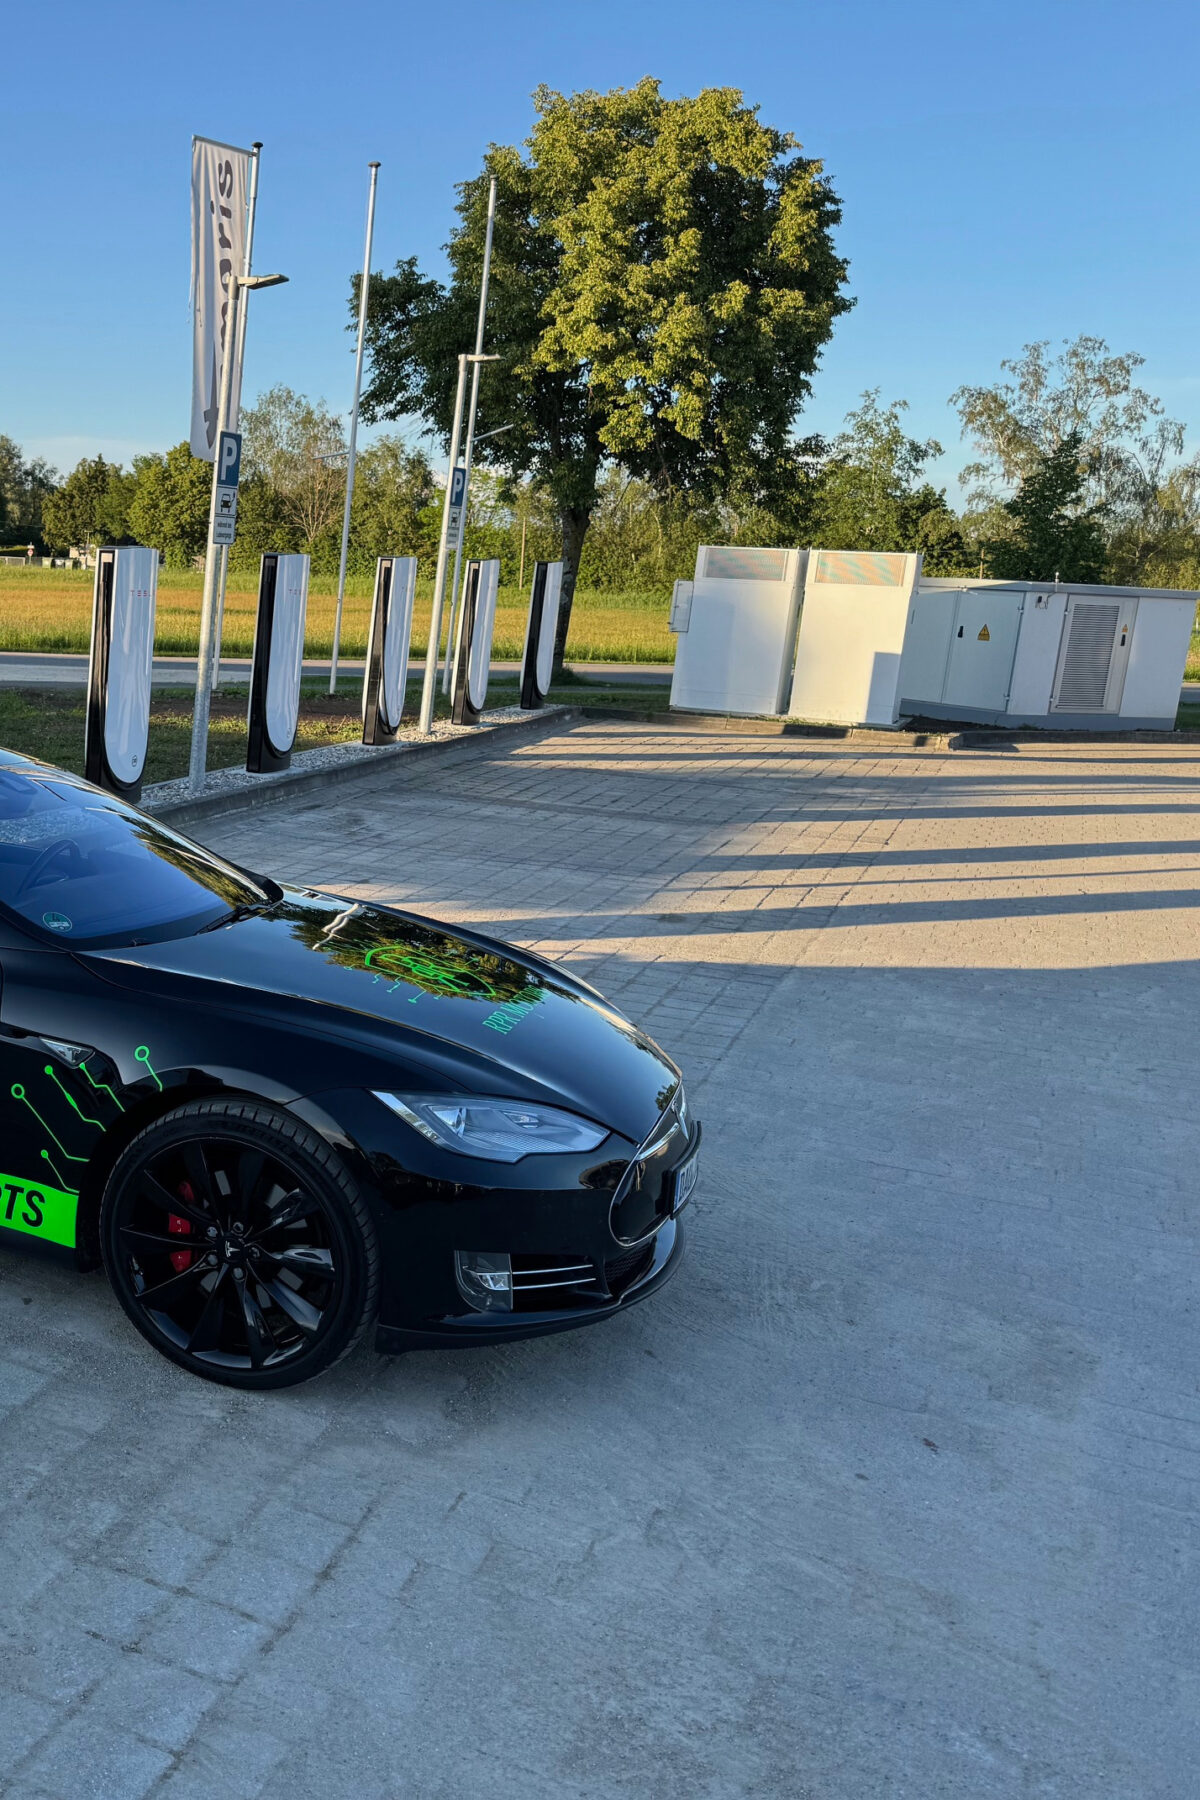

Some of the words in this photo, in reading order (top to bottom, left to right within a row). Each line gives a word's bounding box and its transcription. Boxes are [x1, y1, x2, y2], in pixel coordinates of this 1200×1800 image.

[221, 437, 238, 480] P
[451, 471, 464, 504] P
[482, 1011, 520, 1035] RPR
